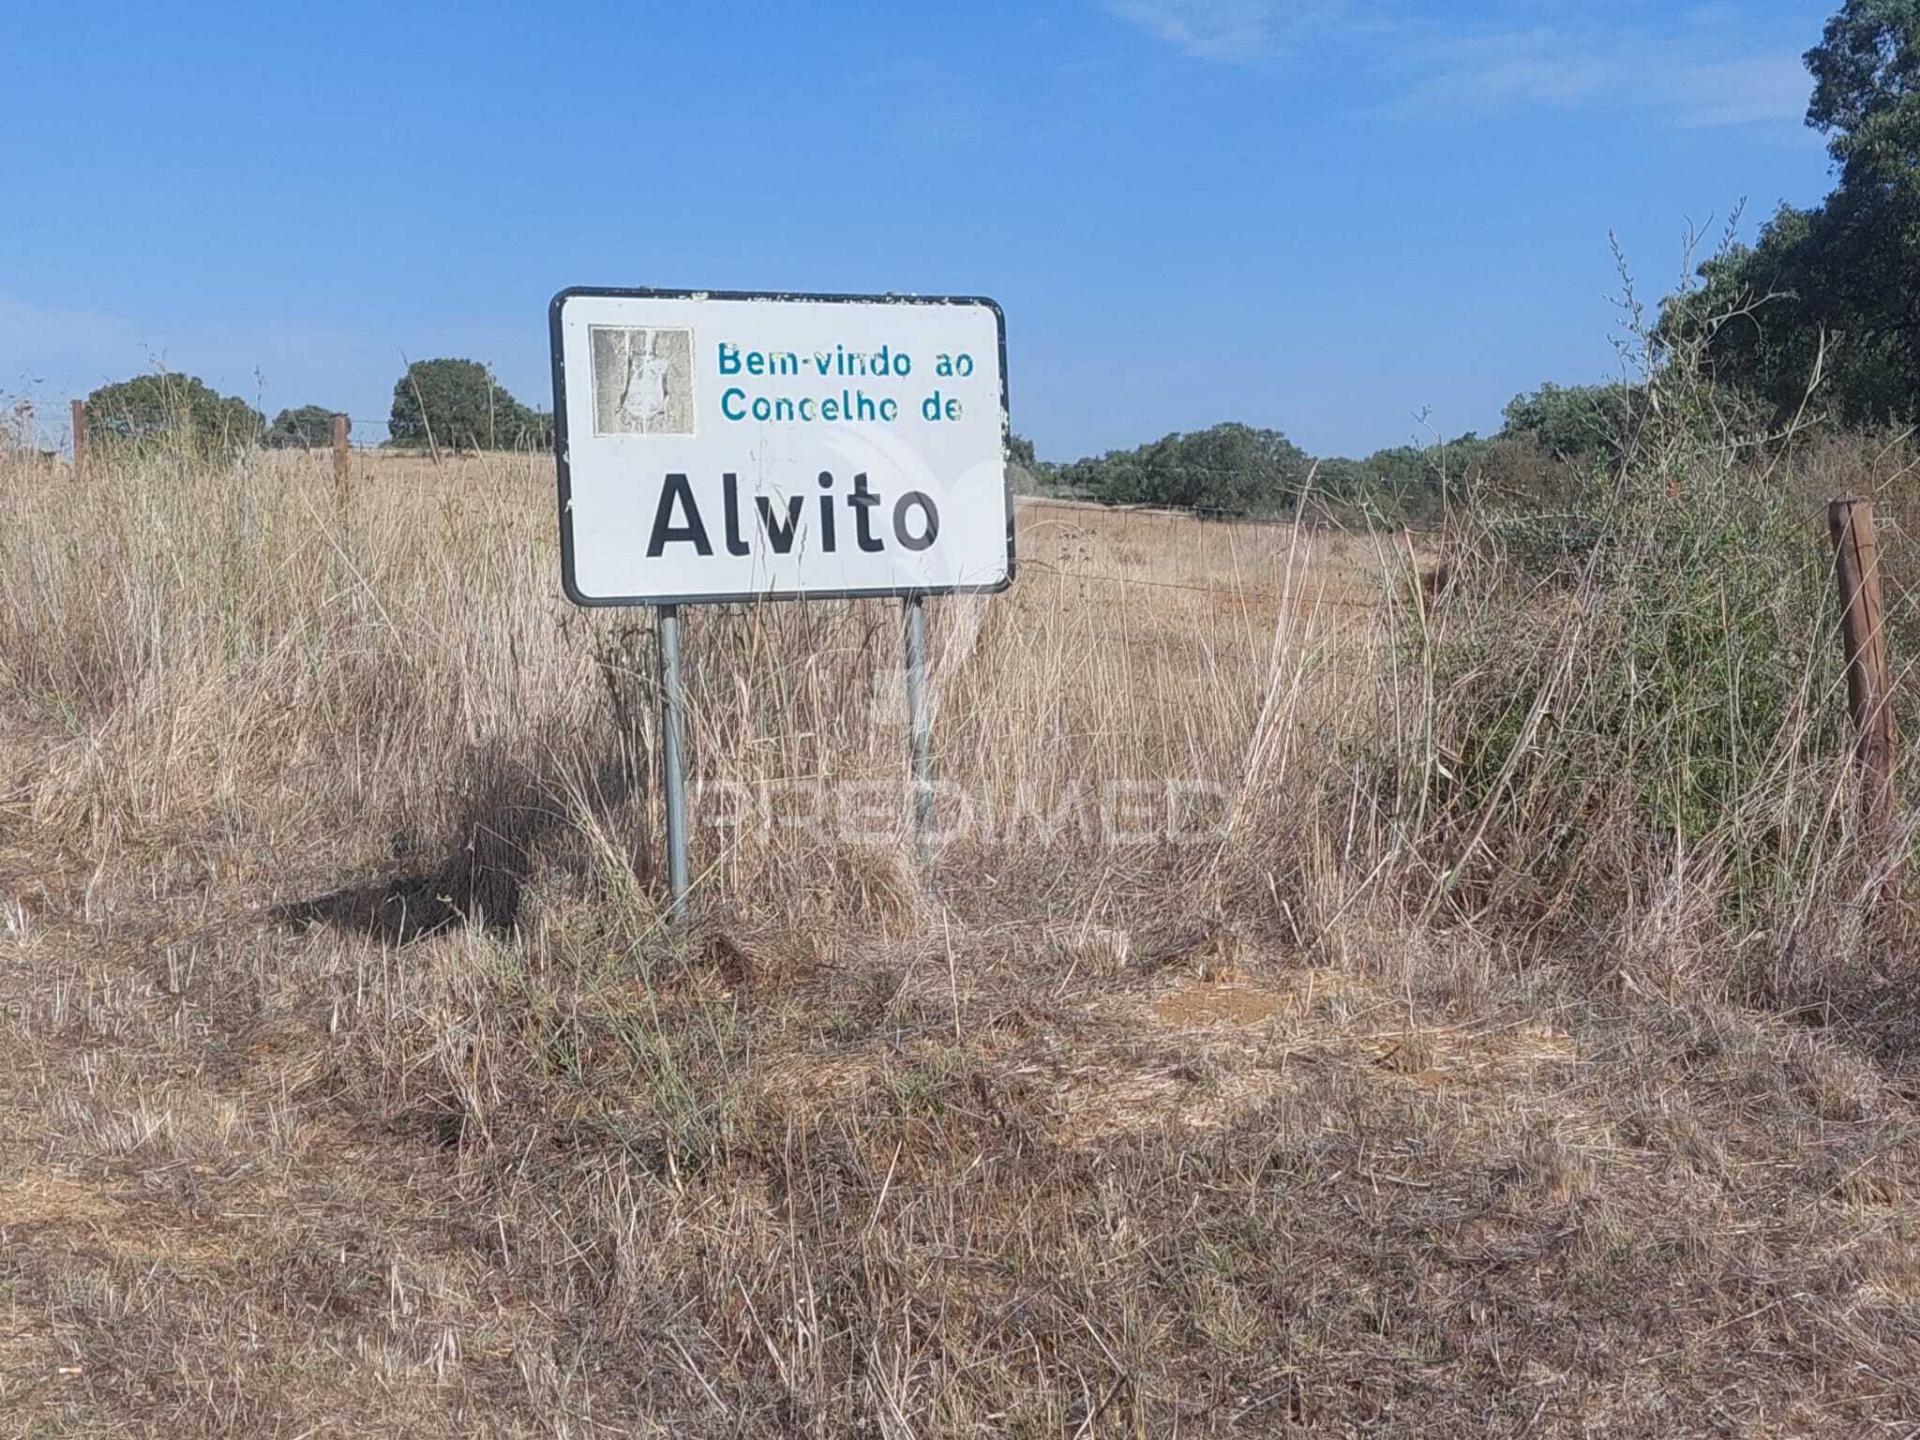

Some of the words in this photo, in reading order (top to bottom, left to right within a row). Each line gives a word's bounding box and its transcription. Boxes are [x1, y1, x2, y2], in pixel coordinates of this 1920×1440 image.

[718, 342, 911, 376] Bem-vindo
[935, 353, 974, 377] ao
[721, 388, 898, 421] Concelho
[921, 390, 963, 421] de
[646, 471, 940, 558] Alvito
